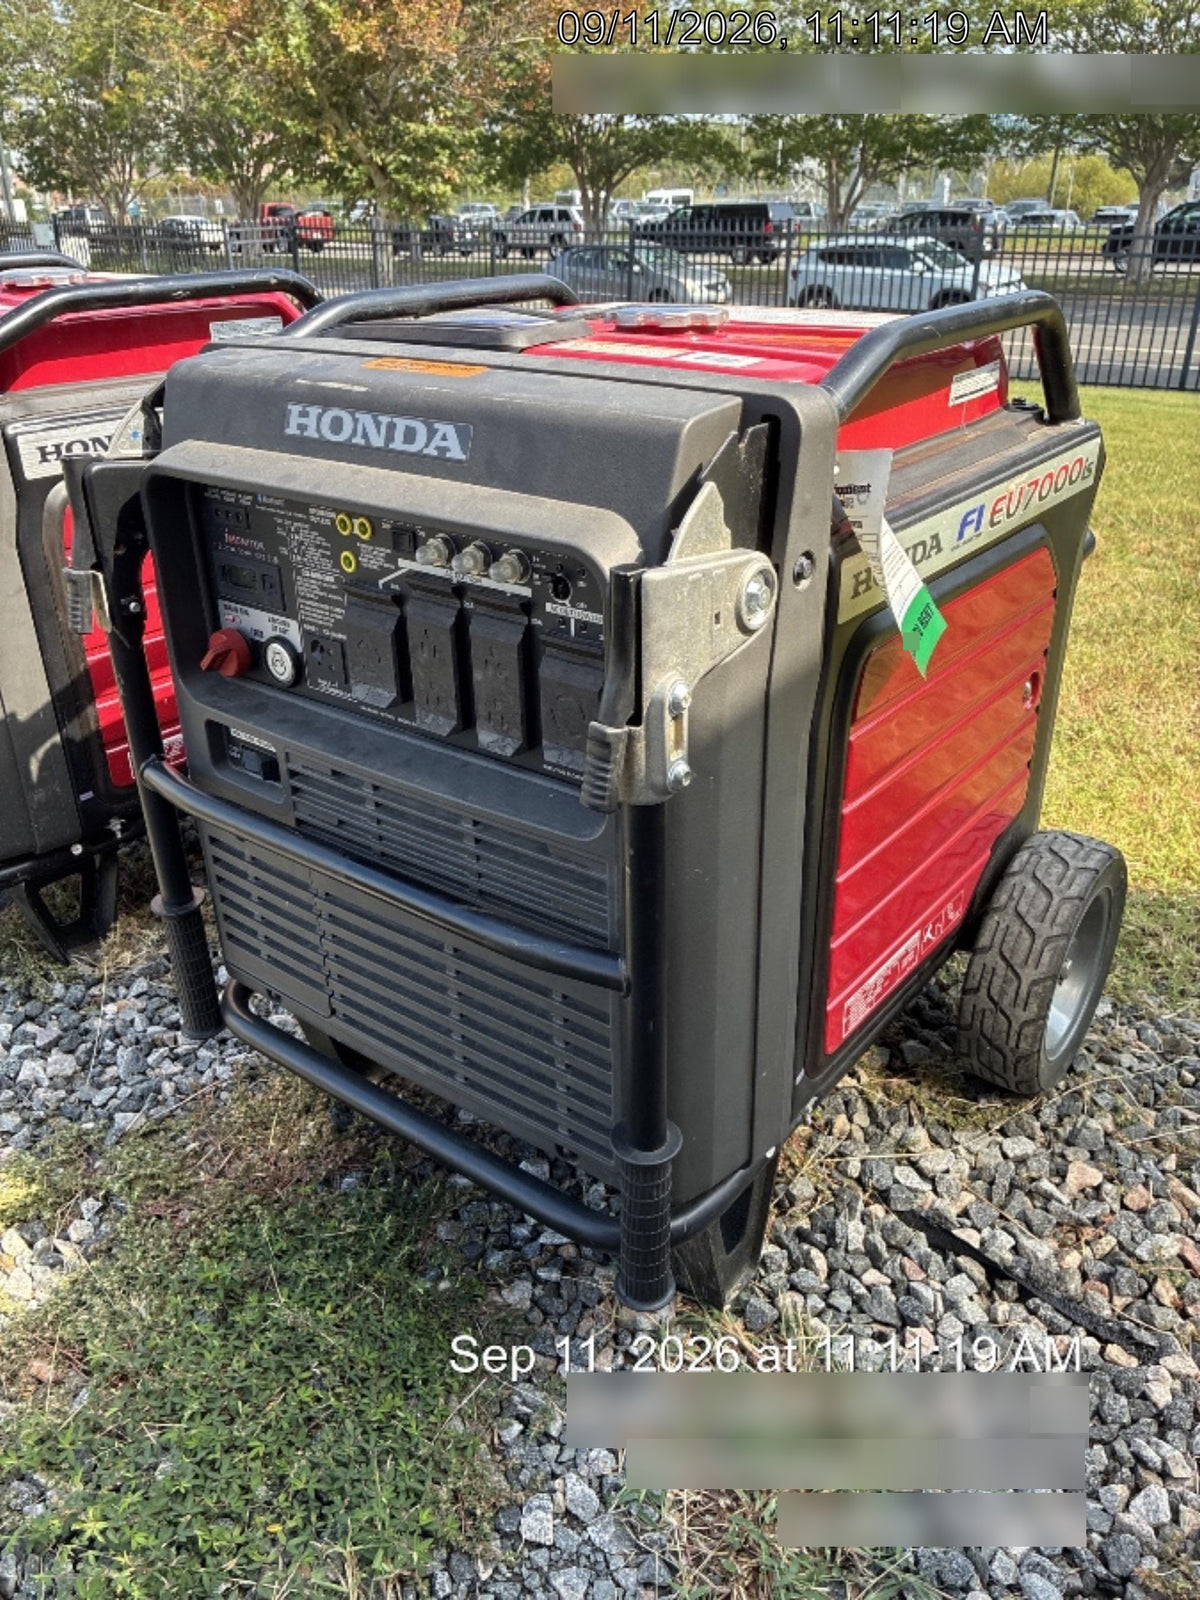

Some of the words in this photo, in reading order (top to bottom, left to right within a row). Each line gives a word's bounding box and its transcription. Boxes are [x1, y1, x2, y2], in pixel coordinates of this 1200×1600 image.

[36, 434, 113, 464] HON
[285, 402, 470, 461] HONDA
[849, 532, 944, 600] HDA
[956, 503, 985, 542] FI
[988, 456, 1094, 529] EU7000is
